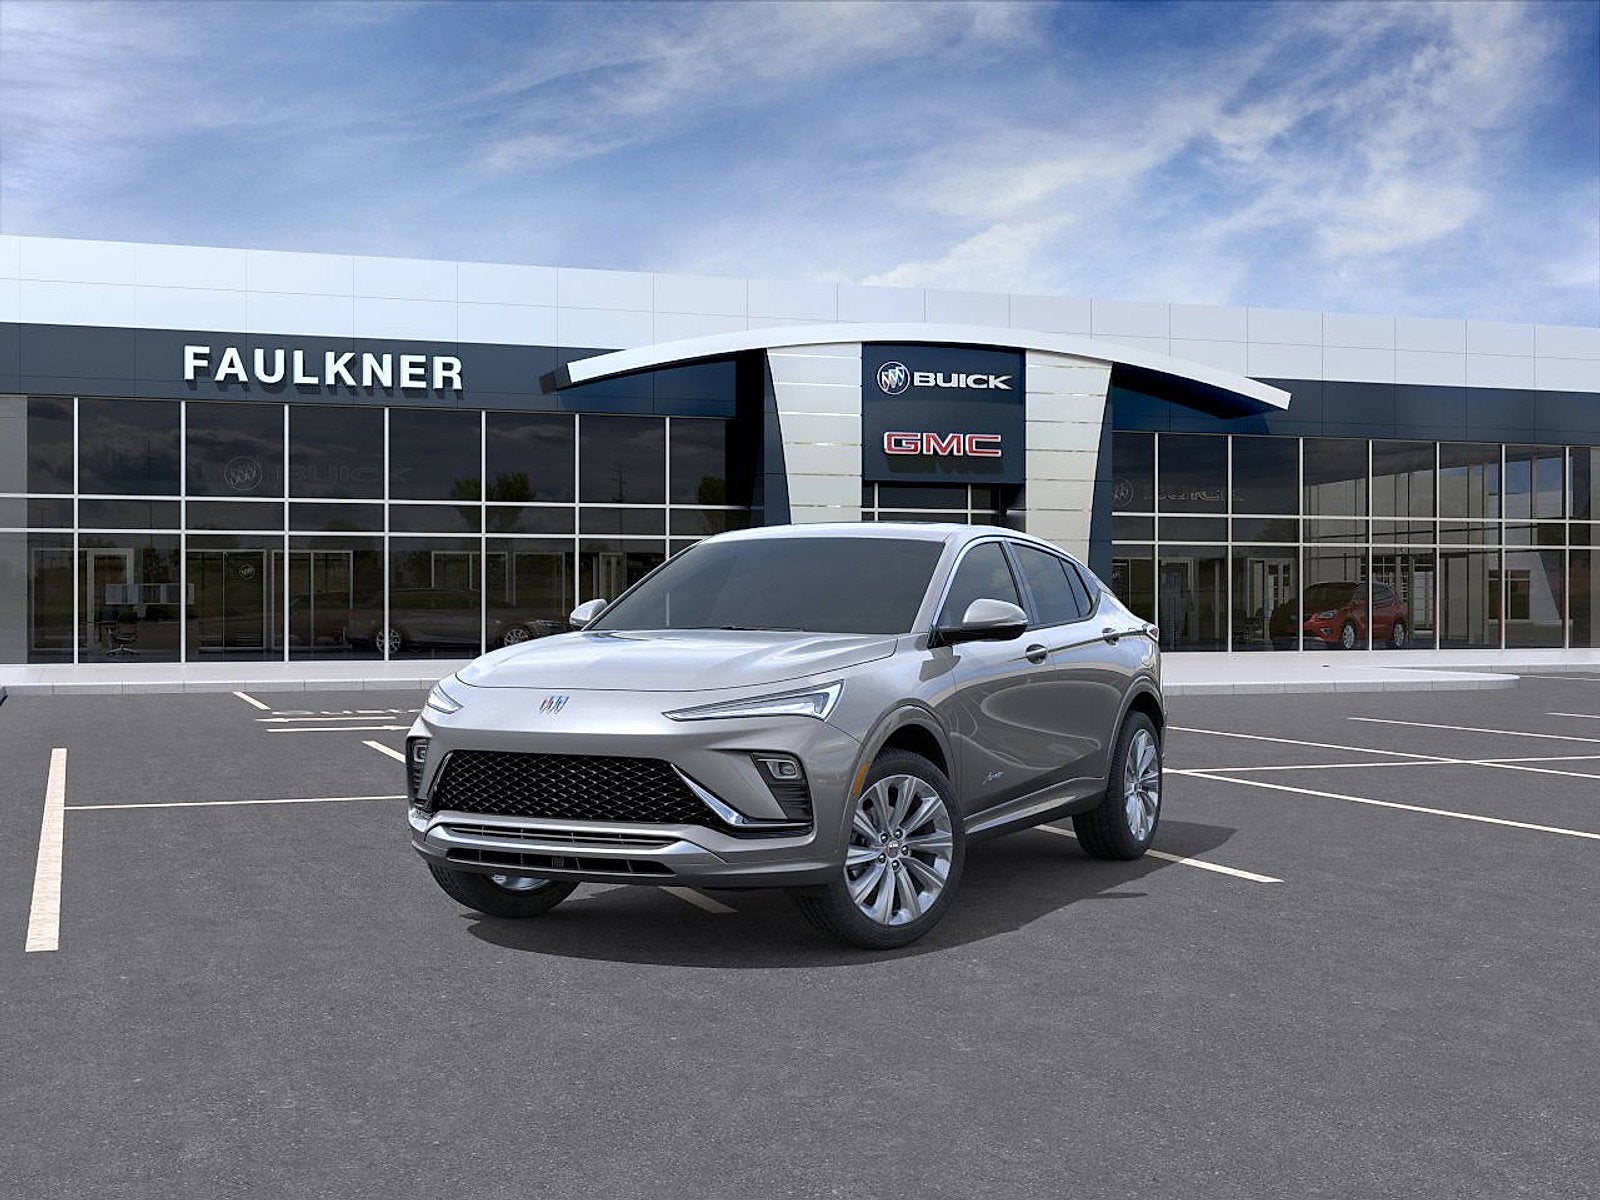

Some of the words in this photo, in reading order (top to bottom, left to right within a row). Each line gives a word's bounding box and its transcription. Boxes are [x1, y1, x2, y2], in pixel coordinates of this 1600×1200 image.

[183, 345, 462, 390] FAULKNER
[914, 372, 1013, 390] BUICK
[884, 431, 1002, 457] GMC
